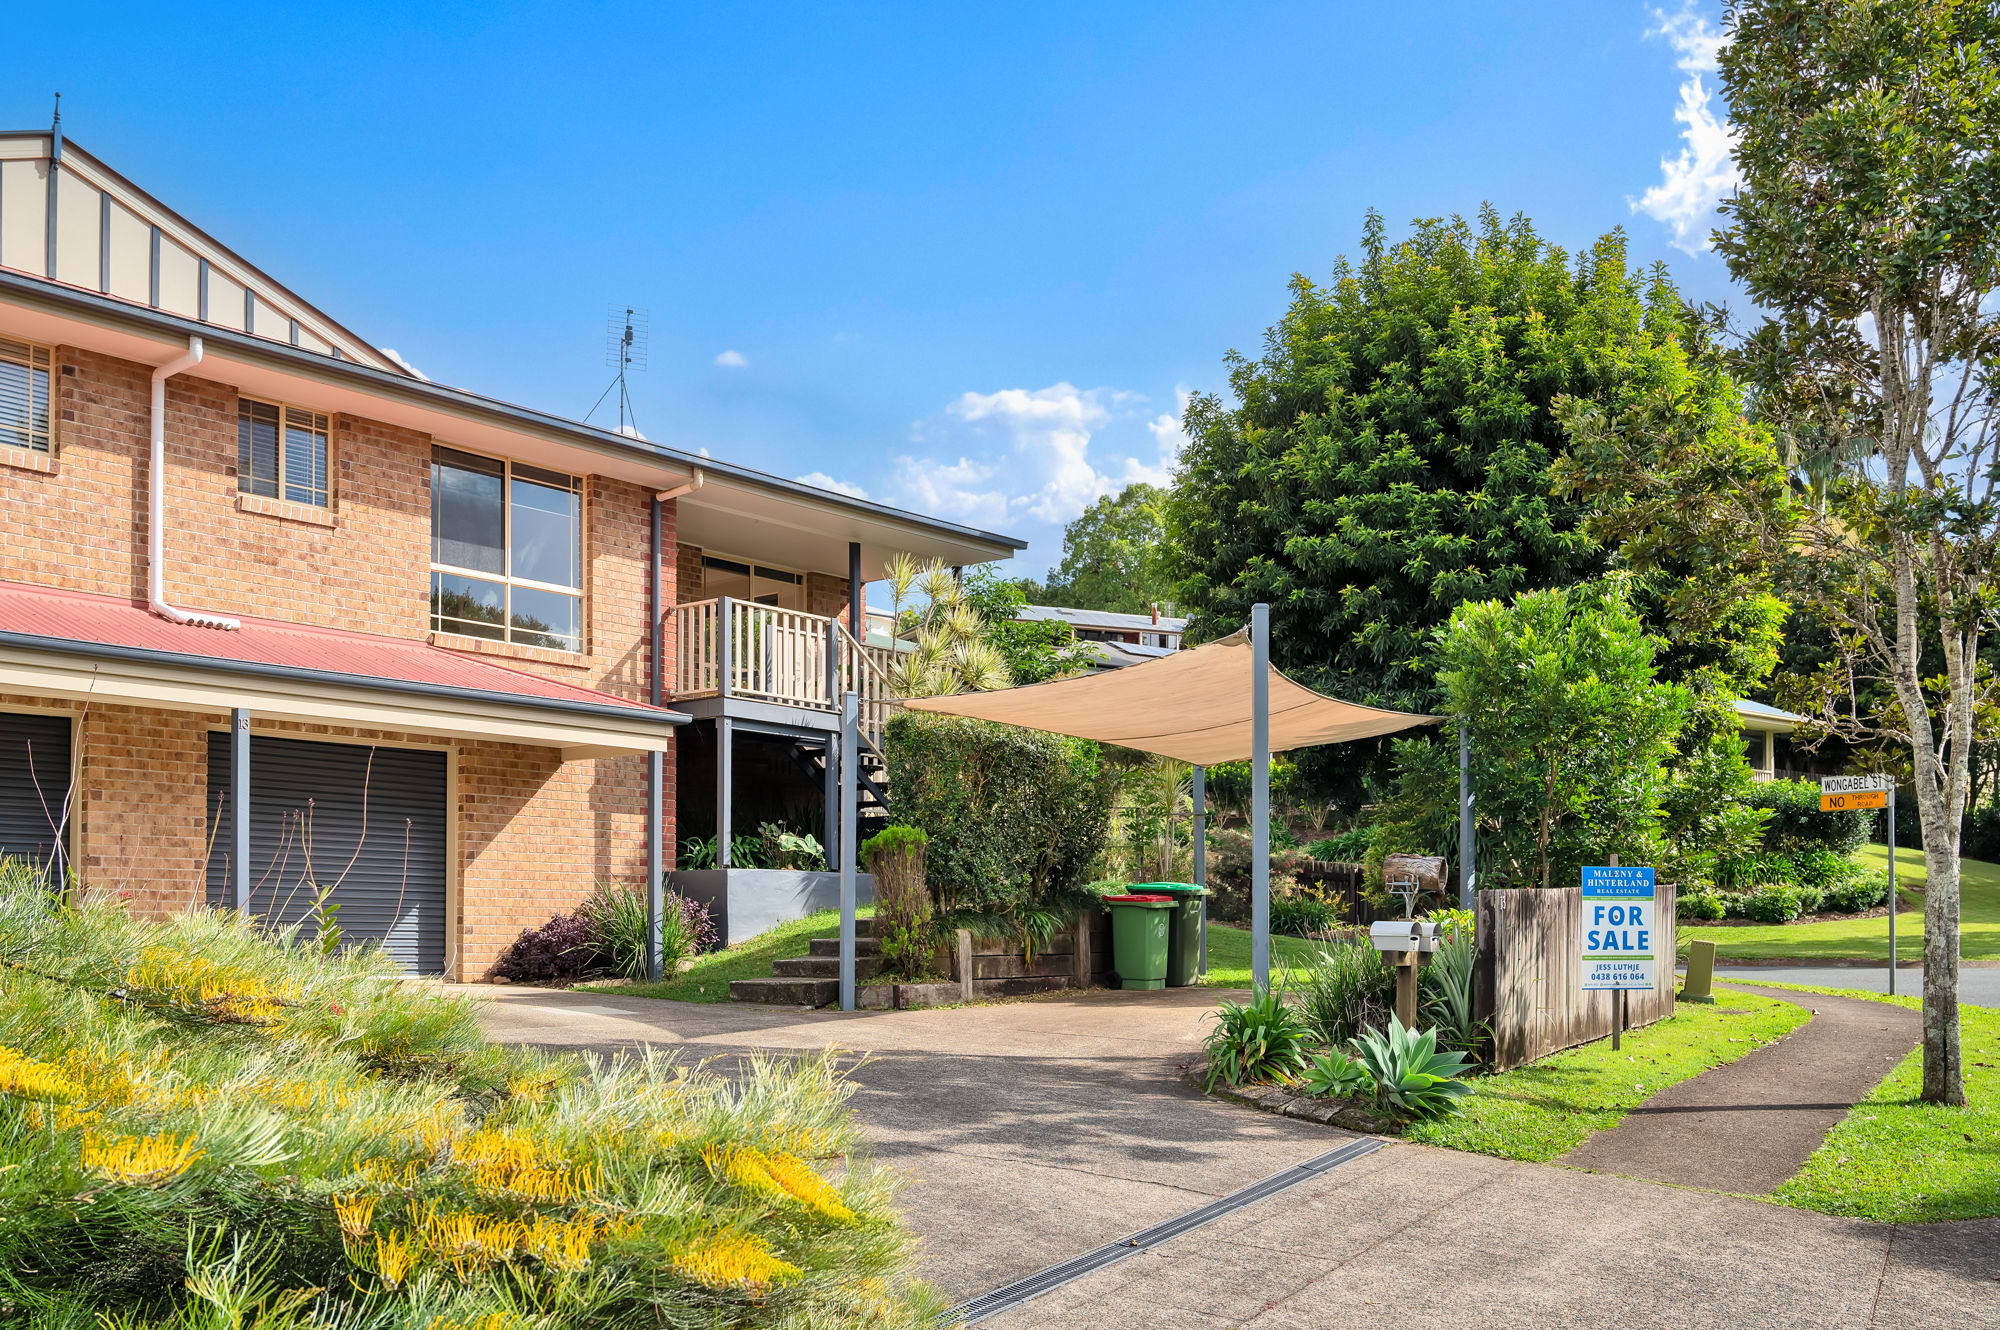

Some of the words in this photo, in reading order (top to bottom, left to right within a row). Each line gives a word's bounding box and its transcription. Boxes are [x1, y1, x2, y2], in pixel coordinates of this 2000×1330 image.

[239, 718, 249, 730] 13
[1824, 777, 1869, 792] WONGABEL
[1872, 776, 1882, 789] ST
[1829, 797, 1845, 809] NO
[1593, 870, 1633, 878] MALENY
[1636, 870, 1643, 878] &
[1587, 879, 1650, 887] HINTERLAND
[1594, 906, 1643, 926] FOR
[1587, 930, 1649, 951] SALE
[1596, 964, 1611, 972] JESS
[1613, 964, 1640, 972] LUTHJE
[1591, 973, 1611, 981] 0438
[1613, 973, 1628, 981] 616
[1630, 973, 1645, 981] 064
